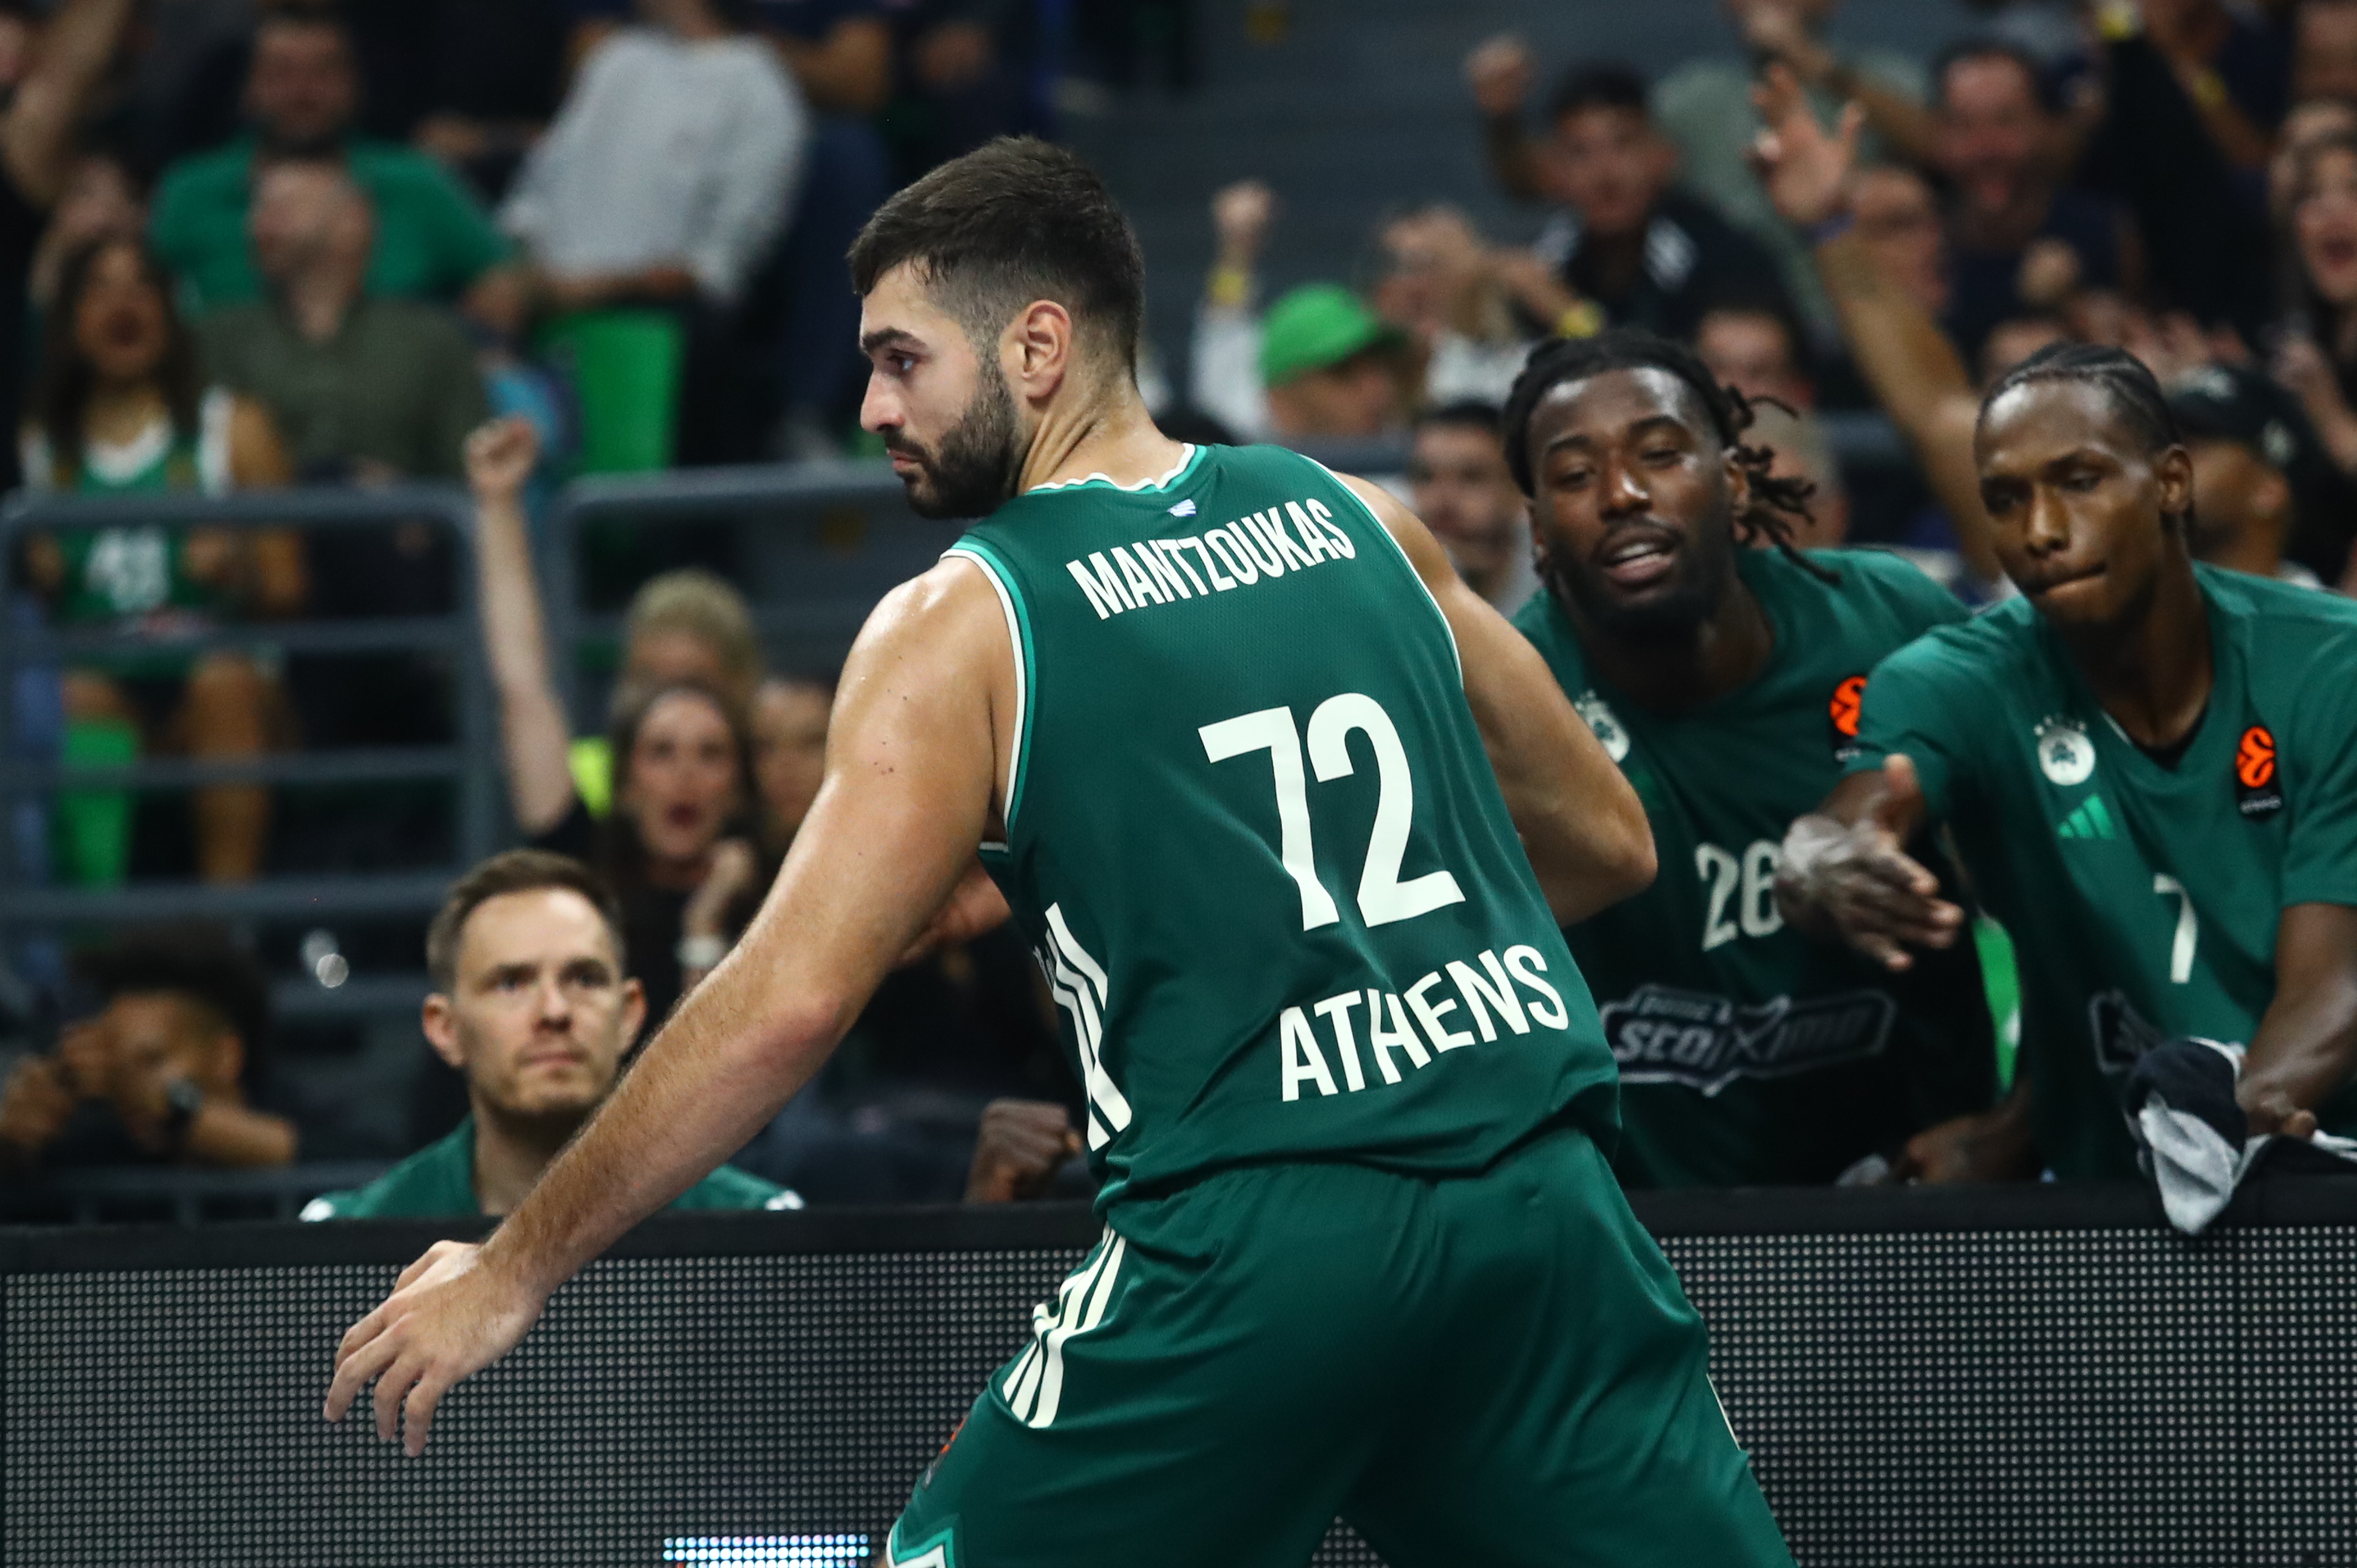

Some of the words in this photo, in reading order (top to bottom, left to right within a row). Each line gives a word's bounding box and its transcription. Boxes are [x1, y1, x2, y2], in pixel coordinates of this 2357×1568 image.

[1066, 498, 1357, 620] MANTZOUKAS
[1198, 692, 1465, 931] 72
[2153, 872, 2199, 984] 7
[1281, 944, 1569, 1102] ATHENS
